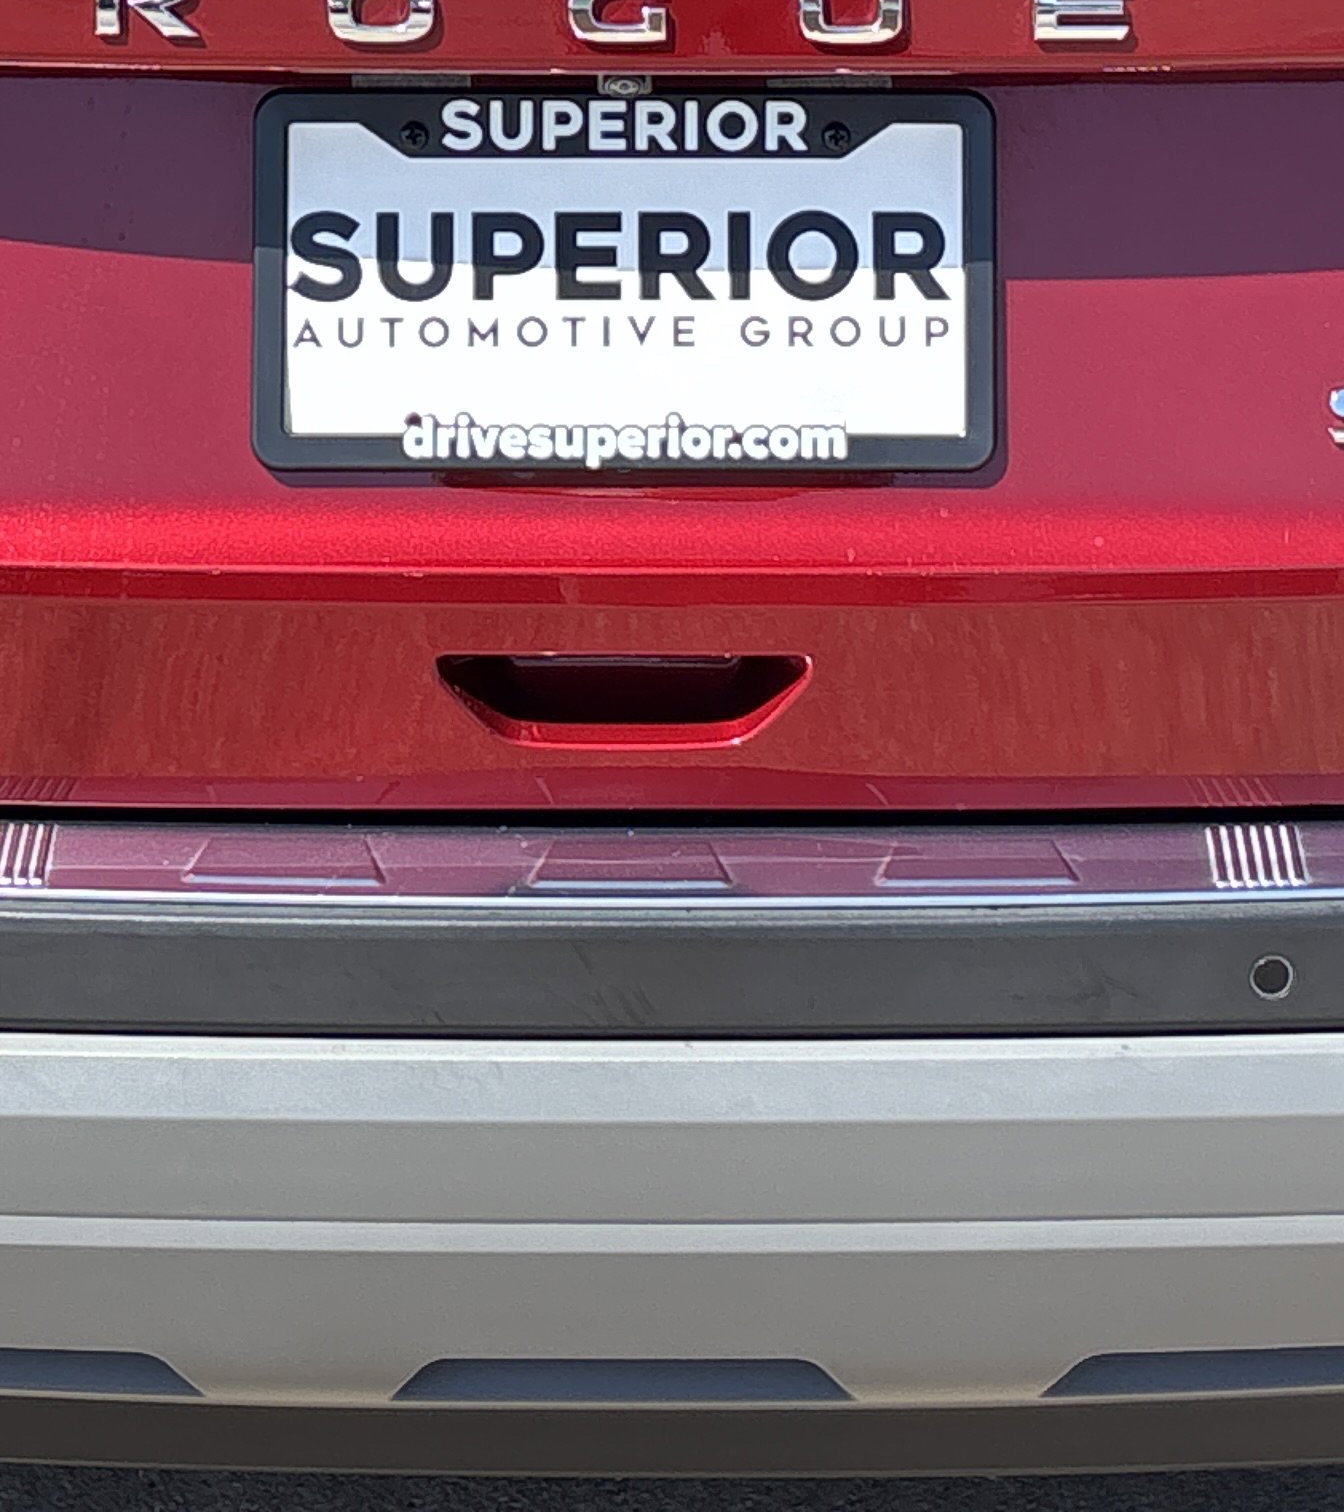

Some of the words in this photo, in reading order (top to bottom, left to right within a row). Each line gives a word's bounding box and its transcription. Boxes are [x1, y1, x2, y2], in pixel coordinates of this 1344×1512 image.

[441, 99, 809, 153] SUPERIOR
[289, 210, 951, 303] SUPERIOR
[293, 317, 698, 349] AUTOMOTIVE
[740, 316, 950, 349] GROUP
[403, 412, 848, 470] drivesuperior.com
